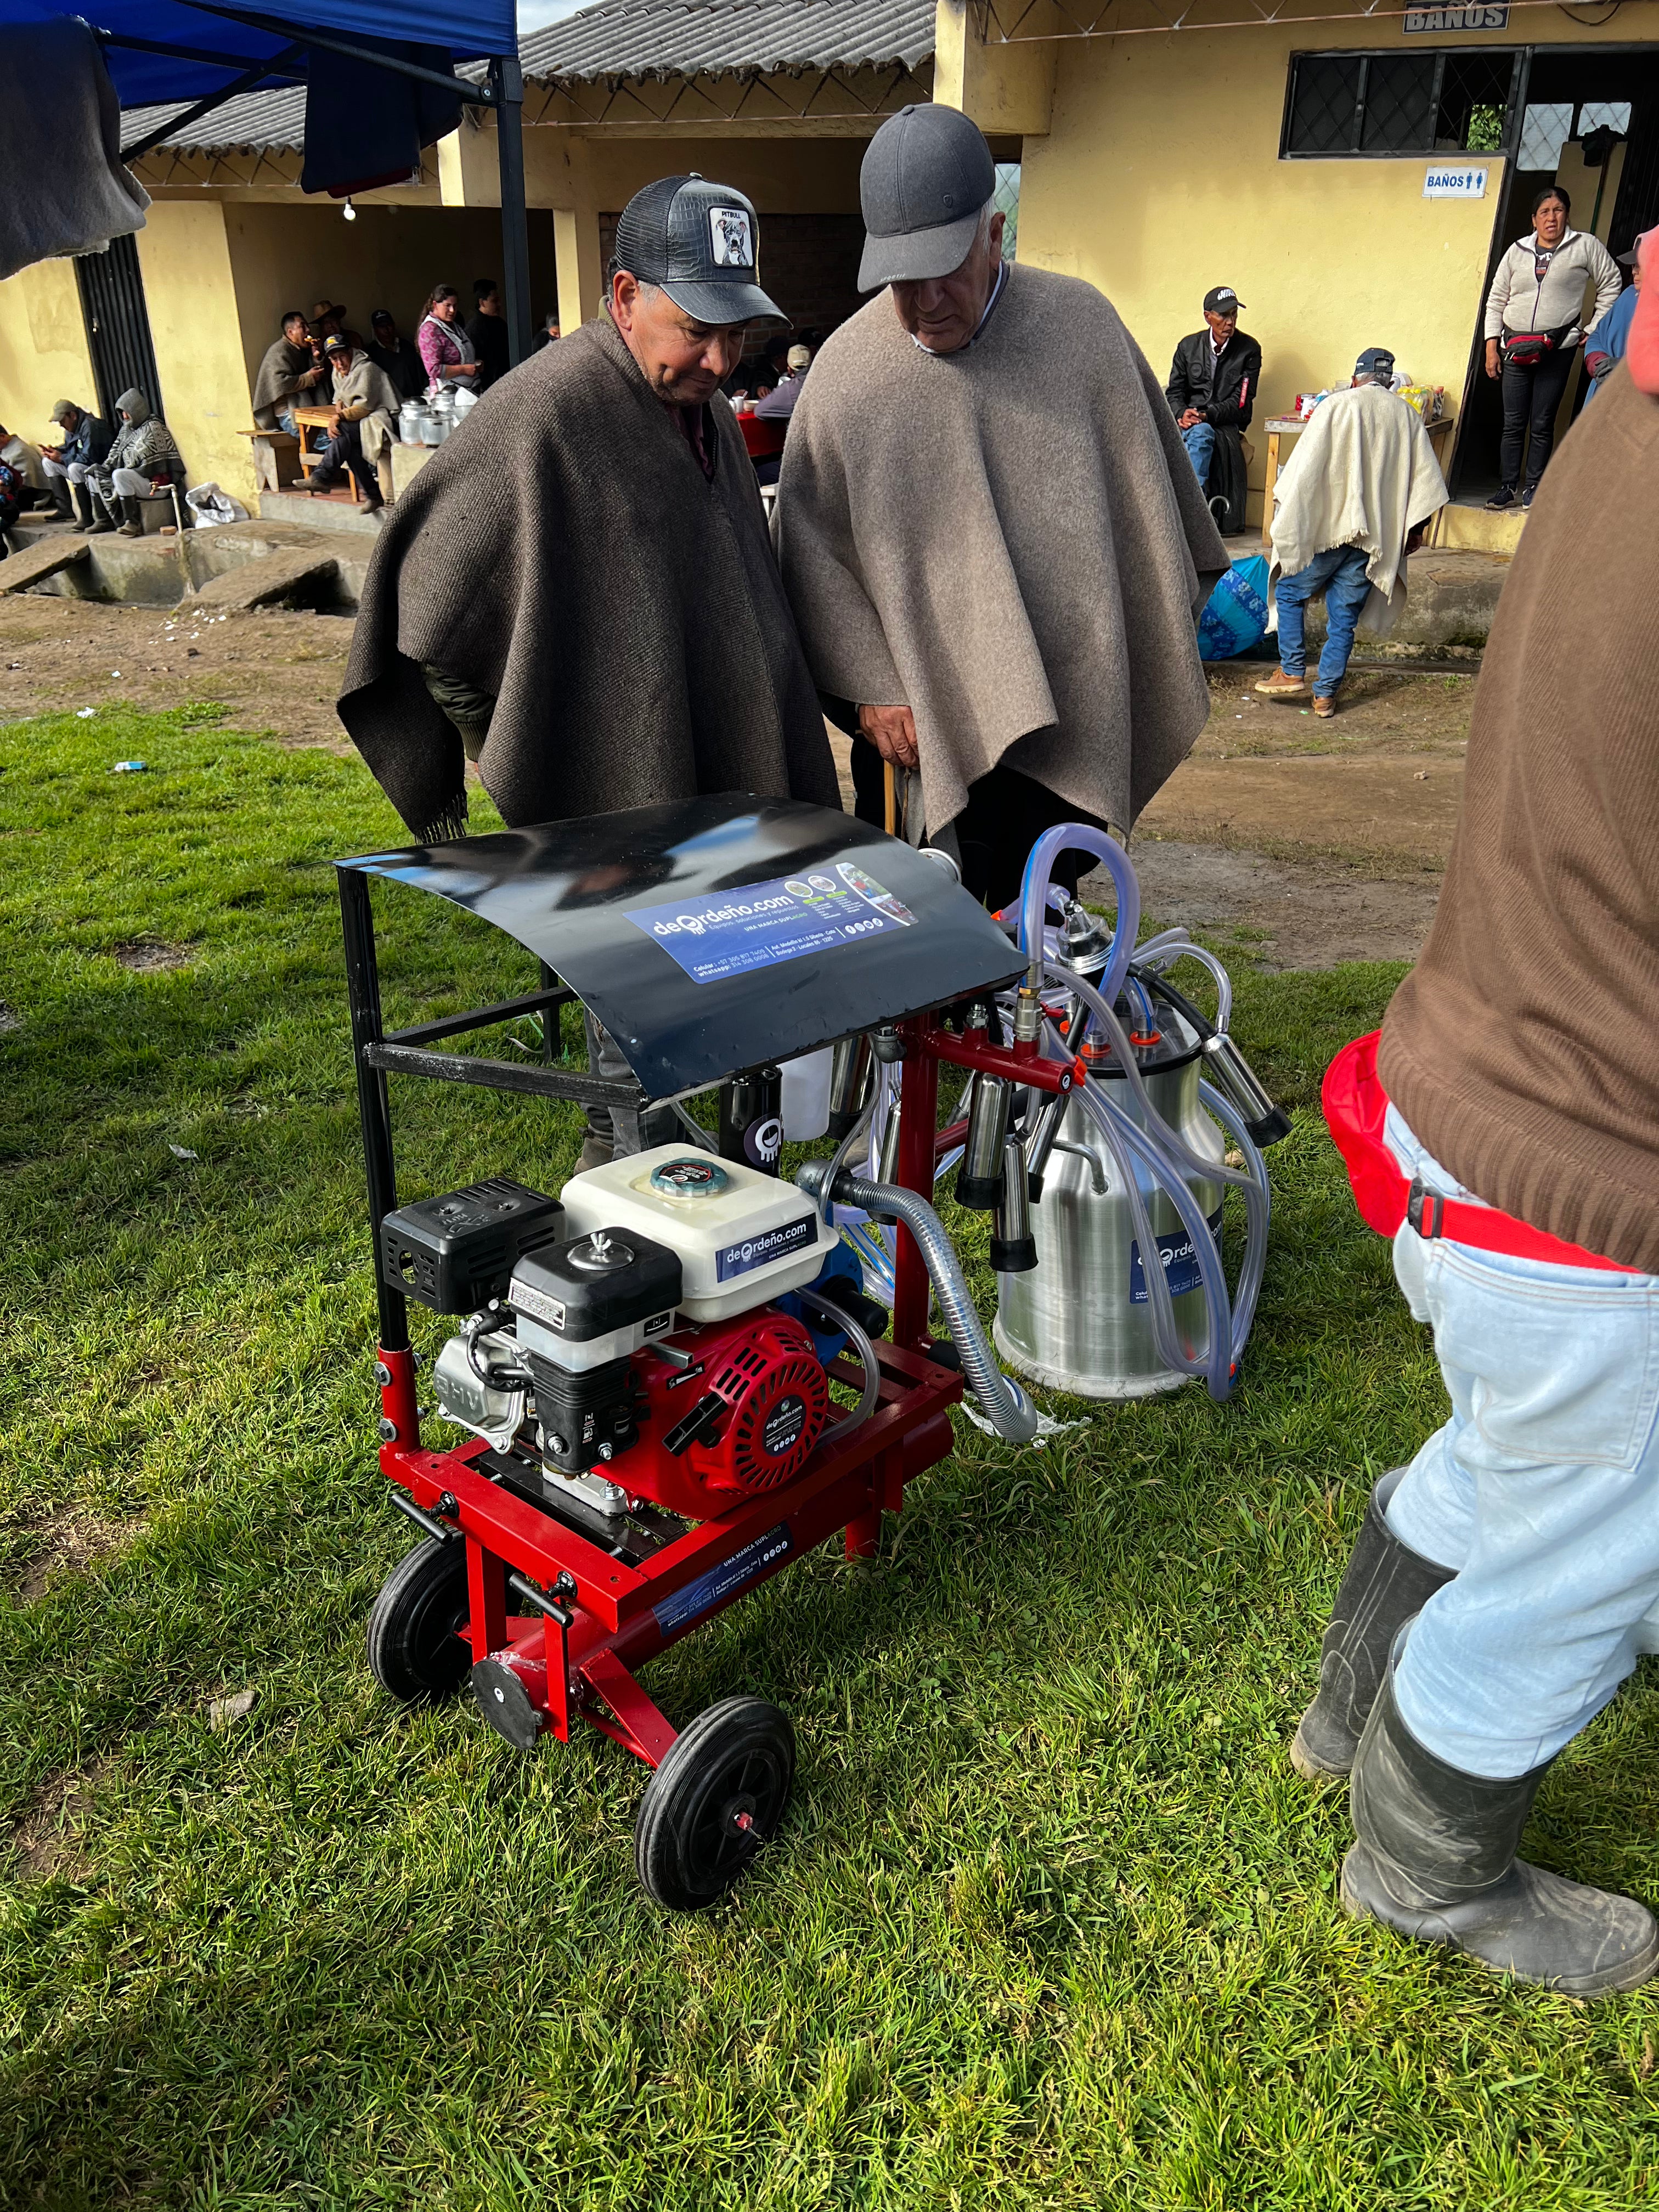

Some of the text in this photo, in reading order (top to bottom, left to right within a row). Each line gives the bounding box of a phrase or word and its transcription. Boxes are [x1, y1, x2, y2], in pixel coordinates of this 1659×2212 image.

[1406, 1, 1504, 31] BAÑOS
[1427, 173, 1464, 187] BAÑOS
[721, 211, 741, 219] PITBULL
[759, 919, 778, 930] MARCA
[778, 912, 808, 924] SUPLAGRO
[724, 1525, 782, 1567] UNA MARCA SUPLAGRO
